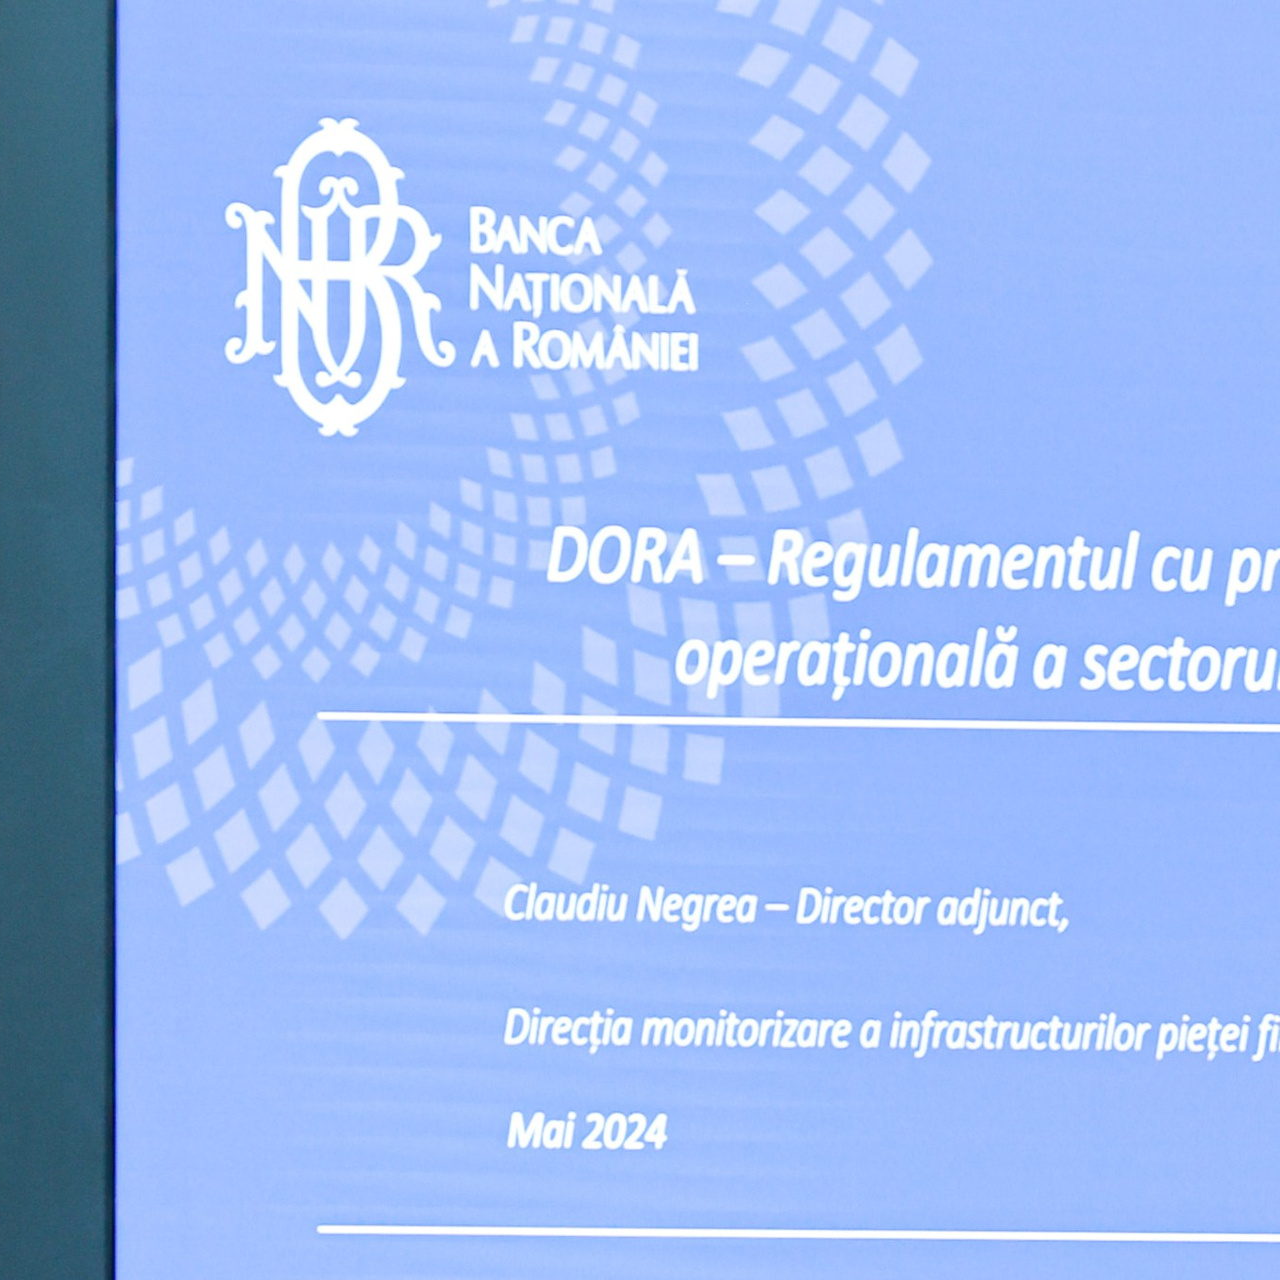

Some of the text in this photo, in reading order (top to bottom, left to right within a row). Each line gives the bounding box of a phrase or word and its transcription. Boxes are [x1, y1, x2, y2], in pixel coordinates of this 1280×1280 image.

[470, 206, 603, 256] BANCA
[513, 321, 699, 372] ROMÂNIEI
[547, 525, 704, 584] DORA
[768, 527, 1140, 602] Regulamentul
[1151, 546, 1213, 592] cu
[1033, 644, 1067, 690] a
[1080, 636, 1280, 692] sectoru
[503, 882, 628, 922] Claudiu
[636, 885, 758, 932] Negrea
[796, 886, 931, 925] Director
[937, 887, 1069, 935] adjunct,
[641, 1009, 852, 1049] monitorizare
[859, 1019, 882, 1048] a
[889, 1010, 1152, 1058] infrastructurilor
[1251, 1013, 1280, 1062] fi
[507, 1111, 668, 1150] Mai 2024
